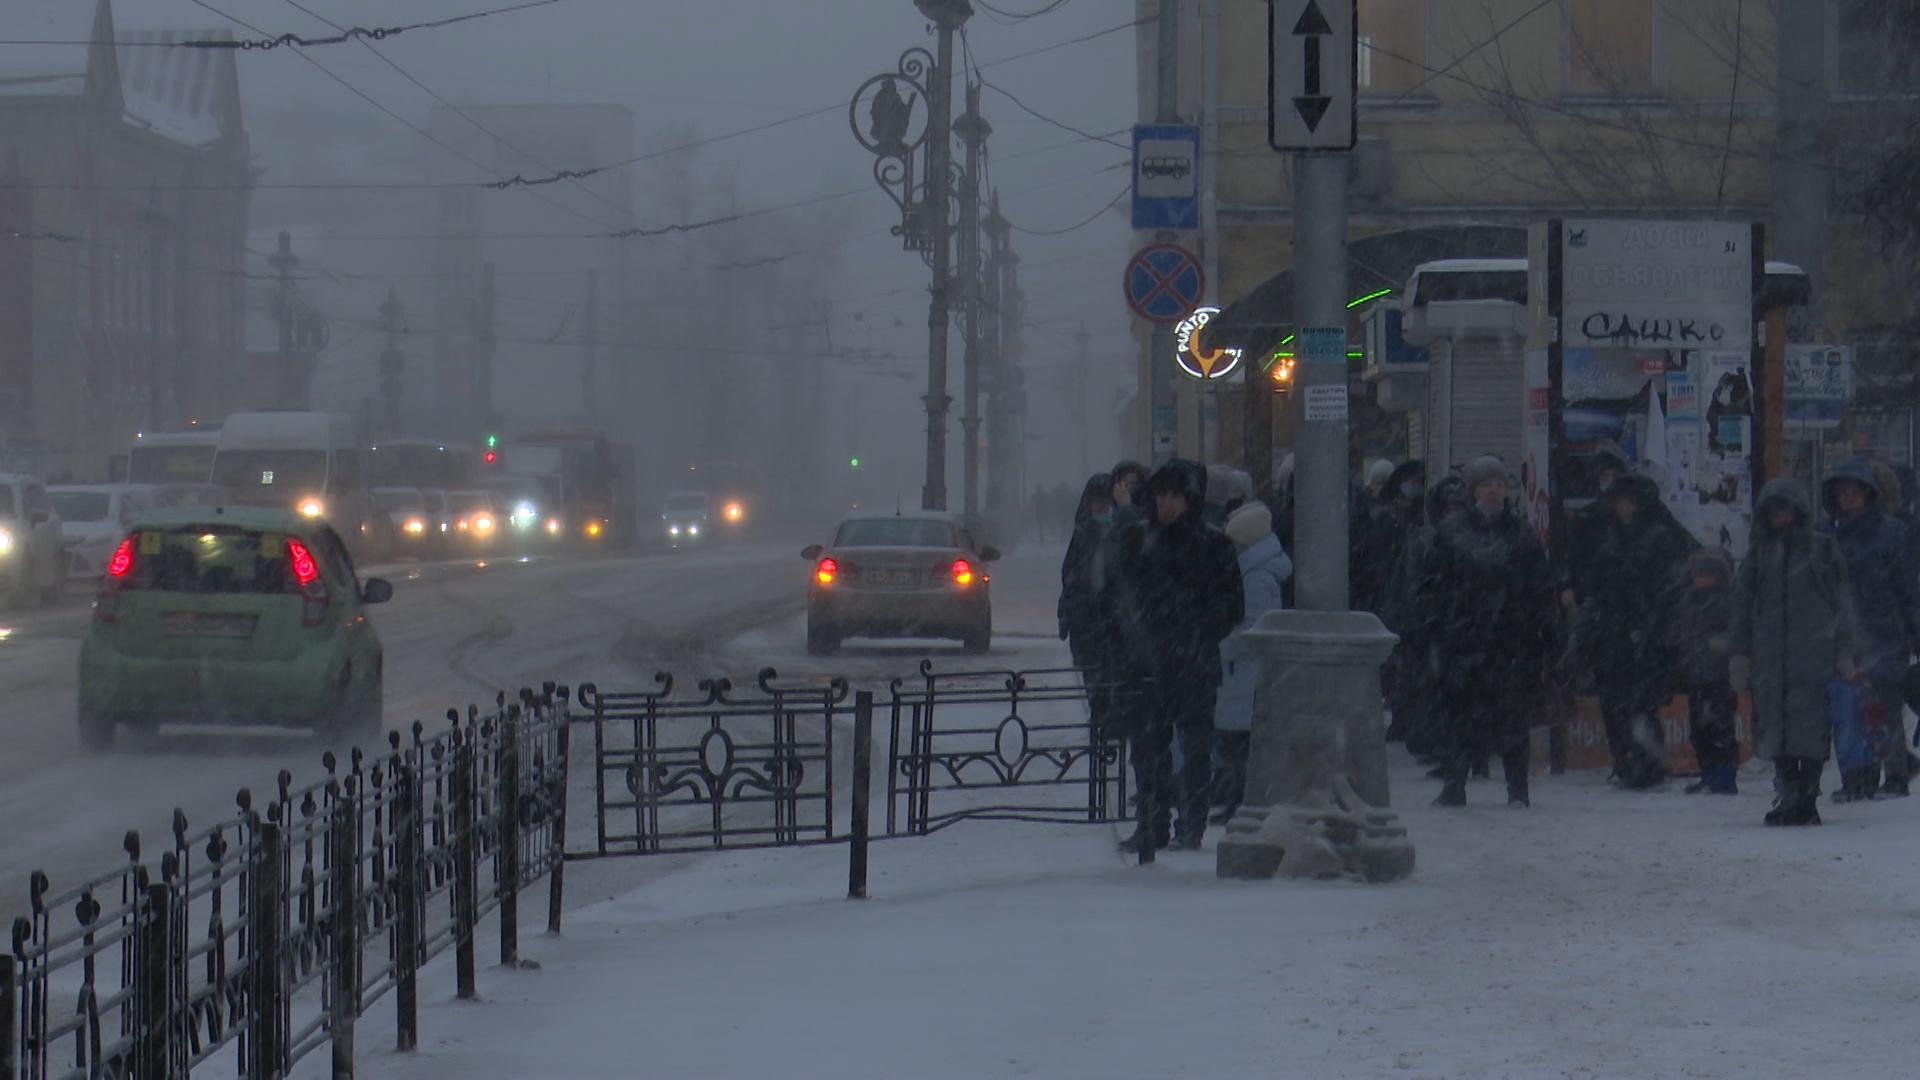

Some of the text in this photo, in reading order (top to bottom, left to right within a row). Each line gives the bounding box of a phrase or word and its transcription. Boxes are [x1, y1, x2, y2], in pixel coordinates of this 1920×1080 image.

[1623, 226, 1710, 250] ДОСКА
[1570, 260, 1744, 288] ОБЪЯВЛЕНИЙ
[1177, 312, 1210, 353] PUNTO
[1582, 312, 1725, 342] САШКО
